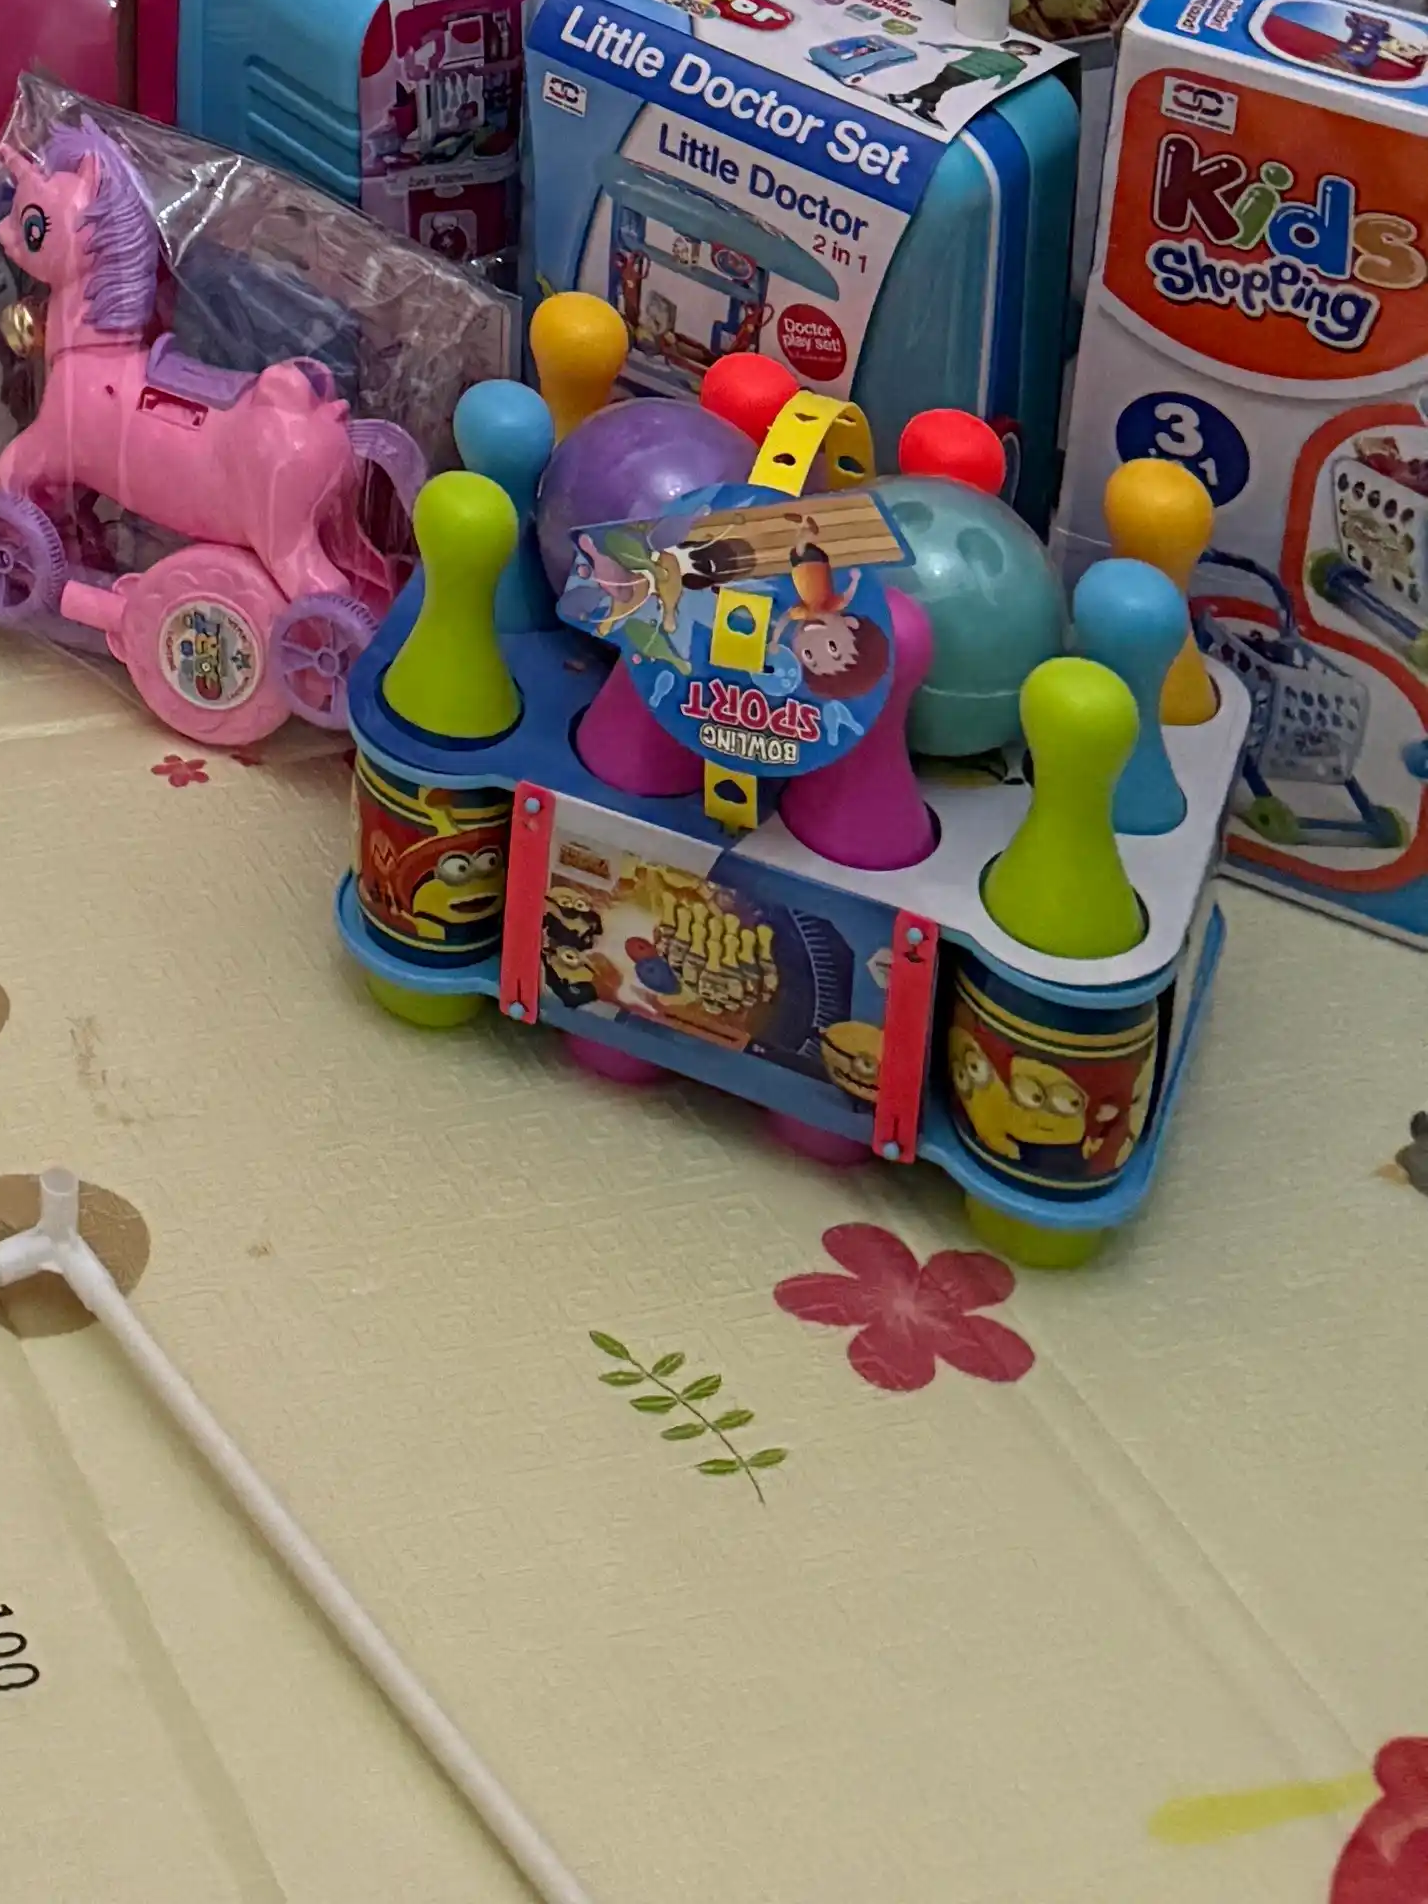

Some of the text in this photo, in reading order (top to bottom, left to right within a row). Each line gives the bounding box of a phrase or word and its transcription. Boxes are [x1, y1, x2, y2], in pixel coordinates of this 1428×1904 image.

[559, 4, 910, 186] Little Doctor Set
[658, 123, 870, 242] Little Doctor
[1152, 132, 1428, 291] Kids
[812, 234, 868, 274] 2 in 1
[1146, 238, 1383, 350] Shopping
[782, 334, 812, 352] play
[783, 318, 834, 338] Doctor
[1154, 402, 1204, 457] 3
[1197, 456, 1219, 486] 1
[679, 677, 822, 743] SPORT
